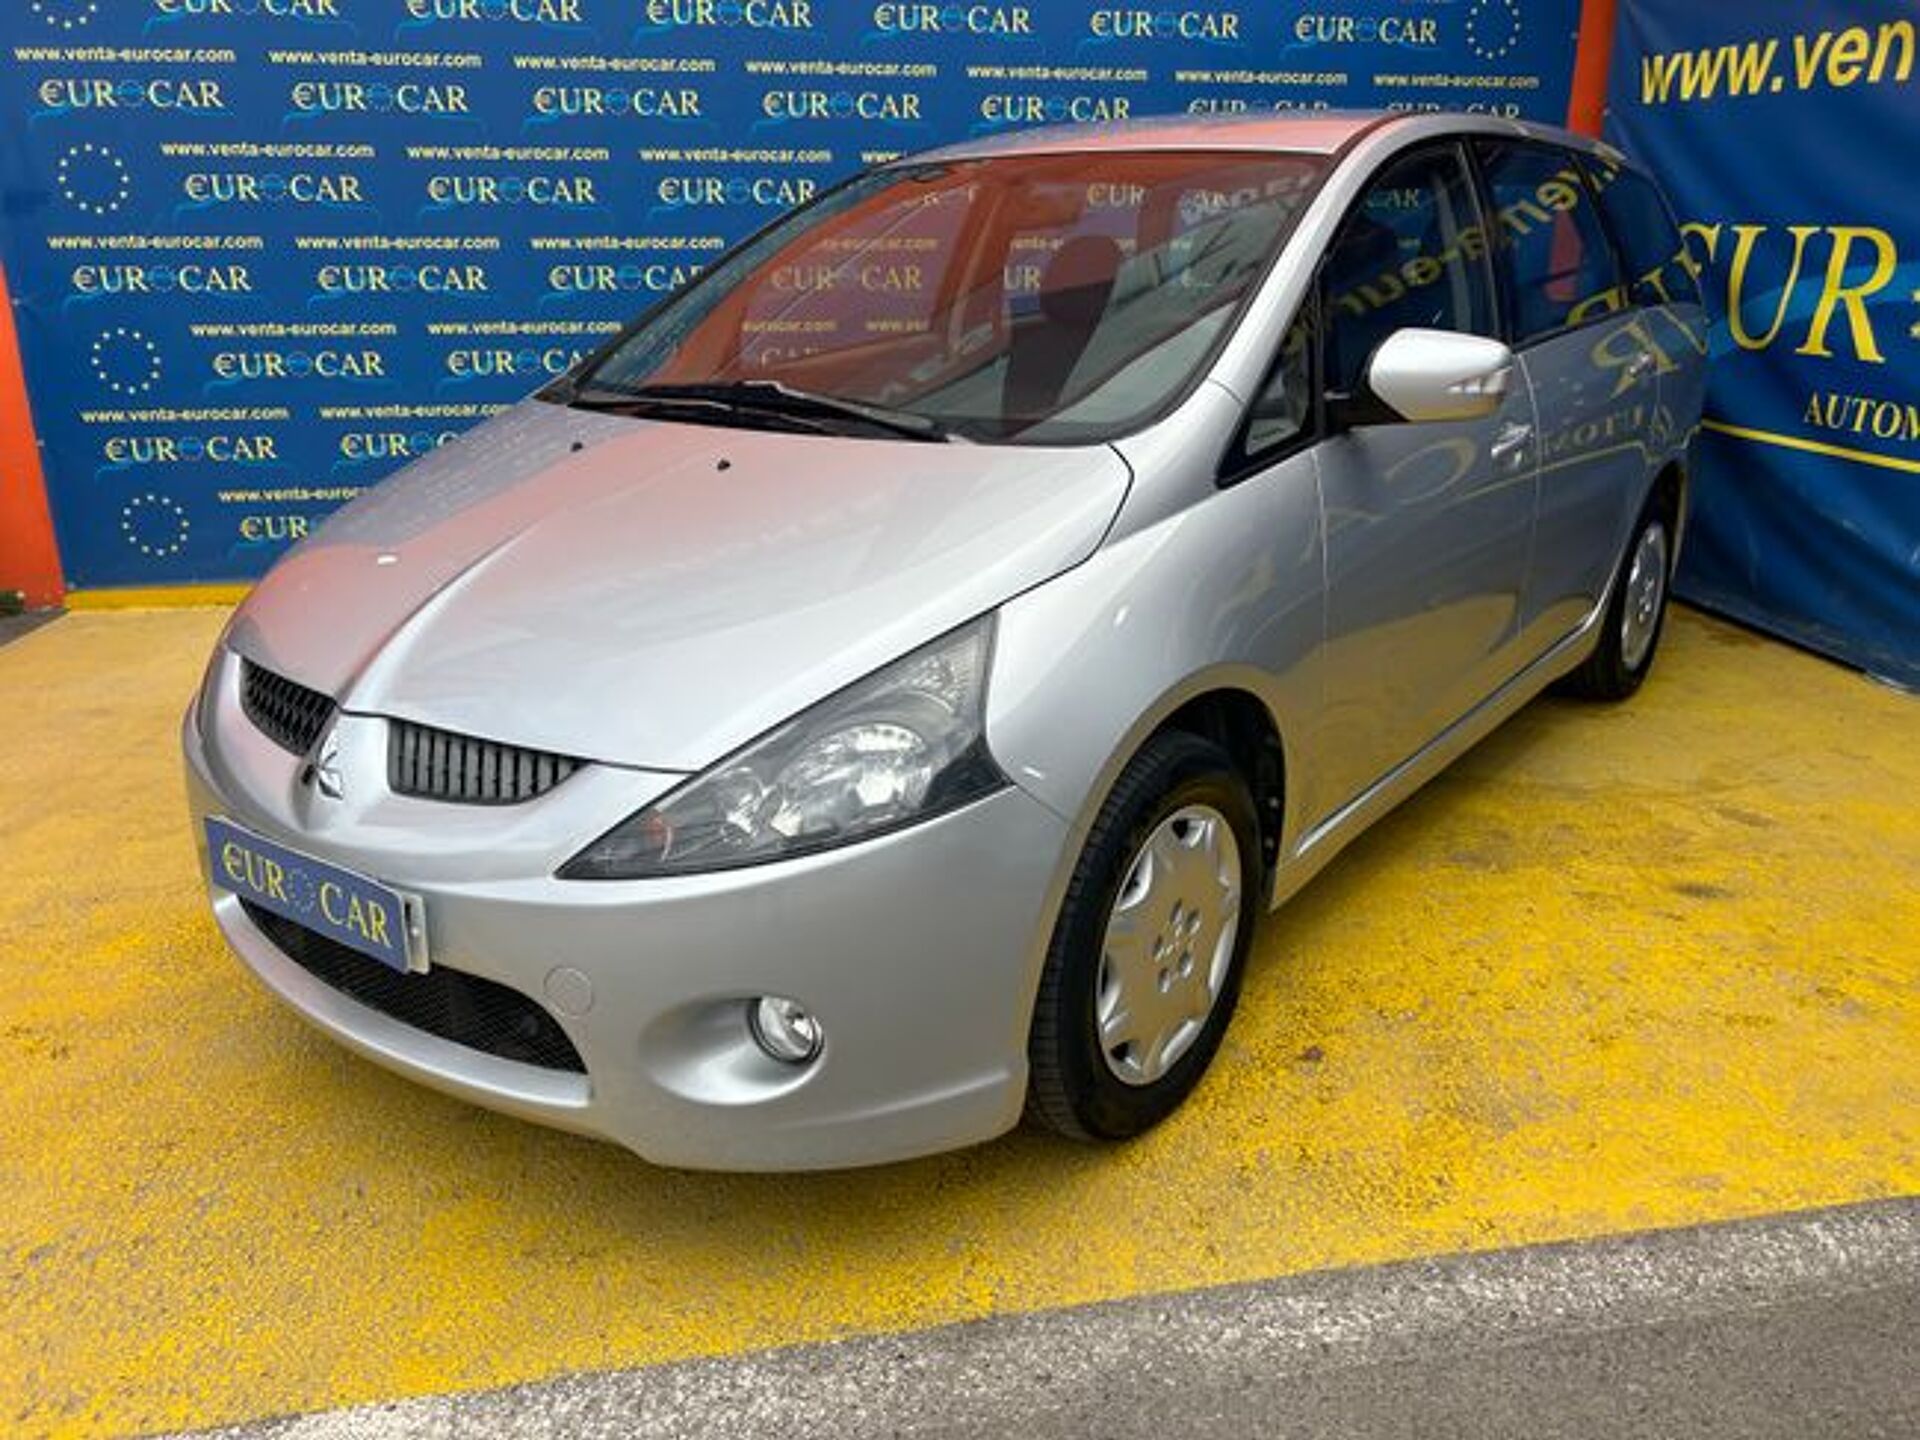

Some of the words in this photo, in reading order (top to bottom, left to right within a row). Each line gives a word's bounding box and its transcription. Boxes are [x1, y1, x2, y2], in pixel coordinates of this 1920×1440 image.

[15, 46, 235, 63] www.venta-eurocar.com
[268, 48, 482, 68] www.venta-eurocar.com
[514, 53, 715, 72] www.venta-eurocar.com
[1642, 20, 1915, 104] www.ven
[745, 59, 937, 77] www.venta-eurocar.com
[966, 63, 1148, 81] www.venta-eurocar.com
[1175, 68, 1347, 86] www.venta-eurocar.com
[1373, 73, 1539, 89] www.venta-eurocar.com
[161, 142, 375, 159] www.venta-eurocar.com
[407, 145, 609, 161] www.venta-eurocar.com
[640, 147, 831, 163] www.venta-eurocar.com
[47, 234, 263, 250] www.venta-eurocar.com
[296, 234, 499, 250] www.venta-eurocar.com
[531, 236, 724, 250] www.venta-eurocar.com
[190, 322, 396, 338] www.venta-eurocar.com
[427, 320, 622, 335] www.venta-eurocar.com
[82, 408, 289, 423] www.venta-eurocar.com
